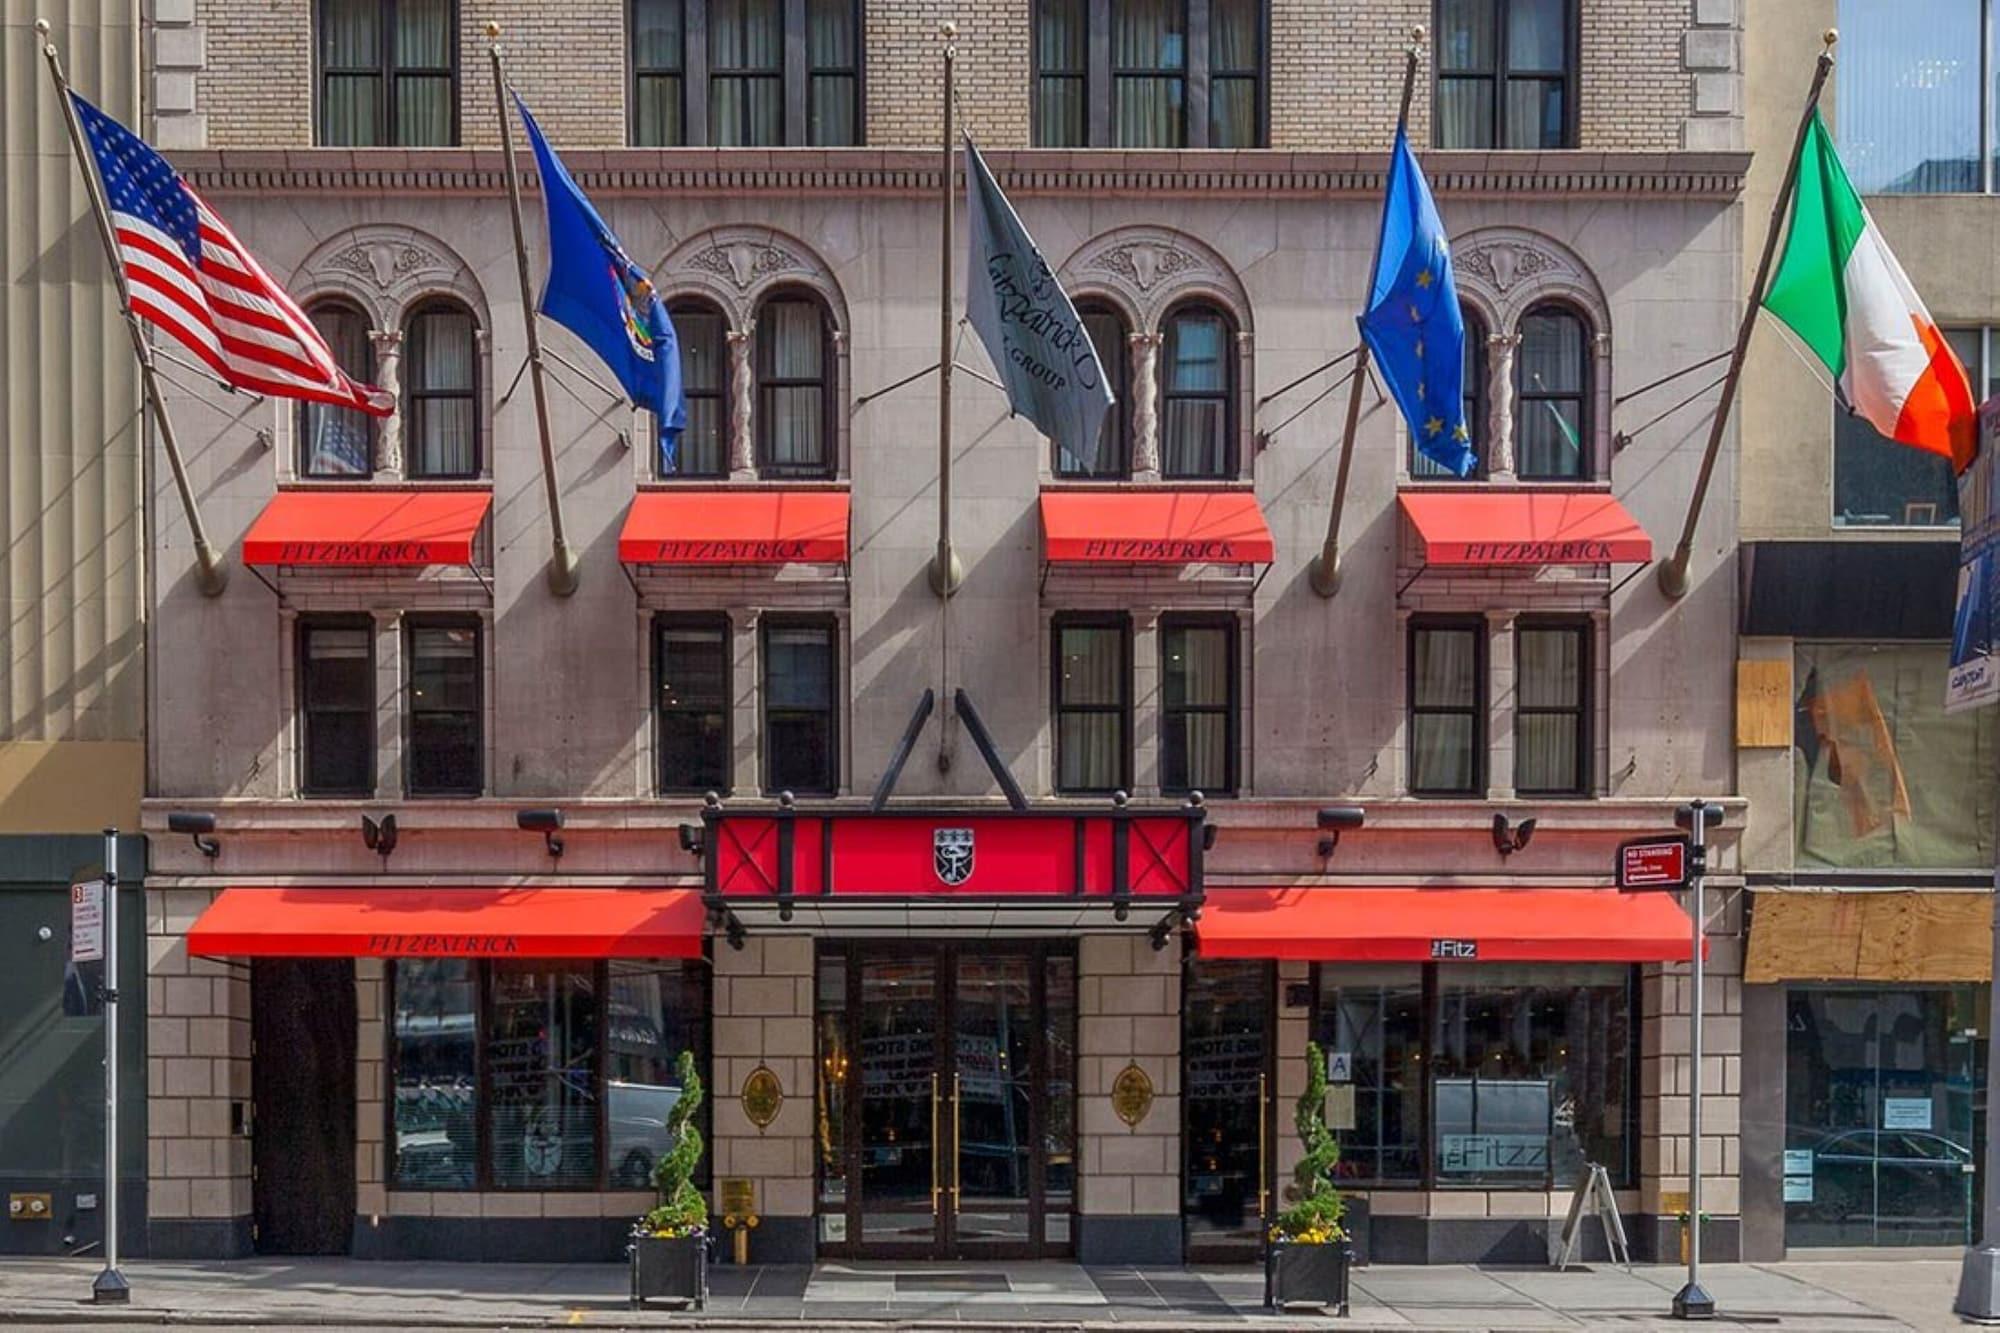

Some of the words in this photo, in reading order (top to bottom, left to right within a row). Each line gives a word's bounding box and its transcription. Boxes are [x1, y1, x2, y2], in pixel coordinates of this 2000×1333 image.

[1010, 347, 1067, 391] GROUP
[281, 543, 430, 560] FITZPATRICK
[658, 541, 808, 558] FITZPATRICK
[1086, 540, 1233, 557] FITZPATRICK
[1465, 543, 1613, 559] FITZPATRICK
[370, 935, 518, 952] FITZPATRICK
[1441, 940, 1475, 957] Fitz
[1332, 1056, 1347, 1073] A
